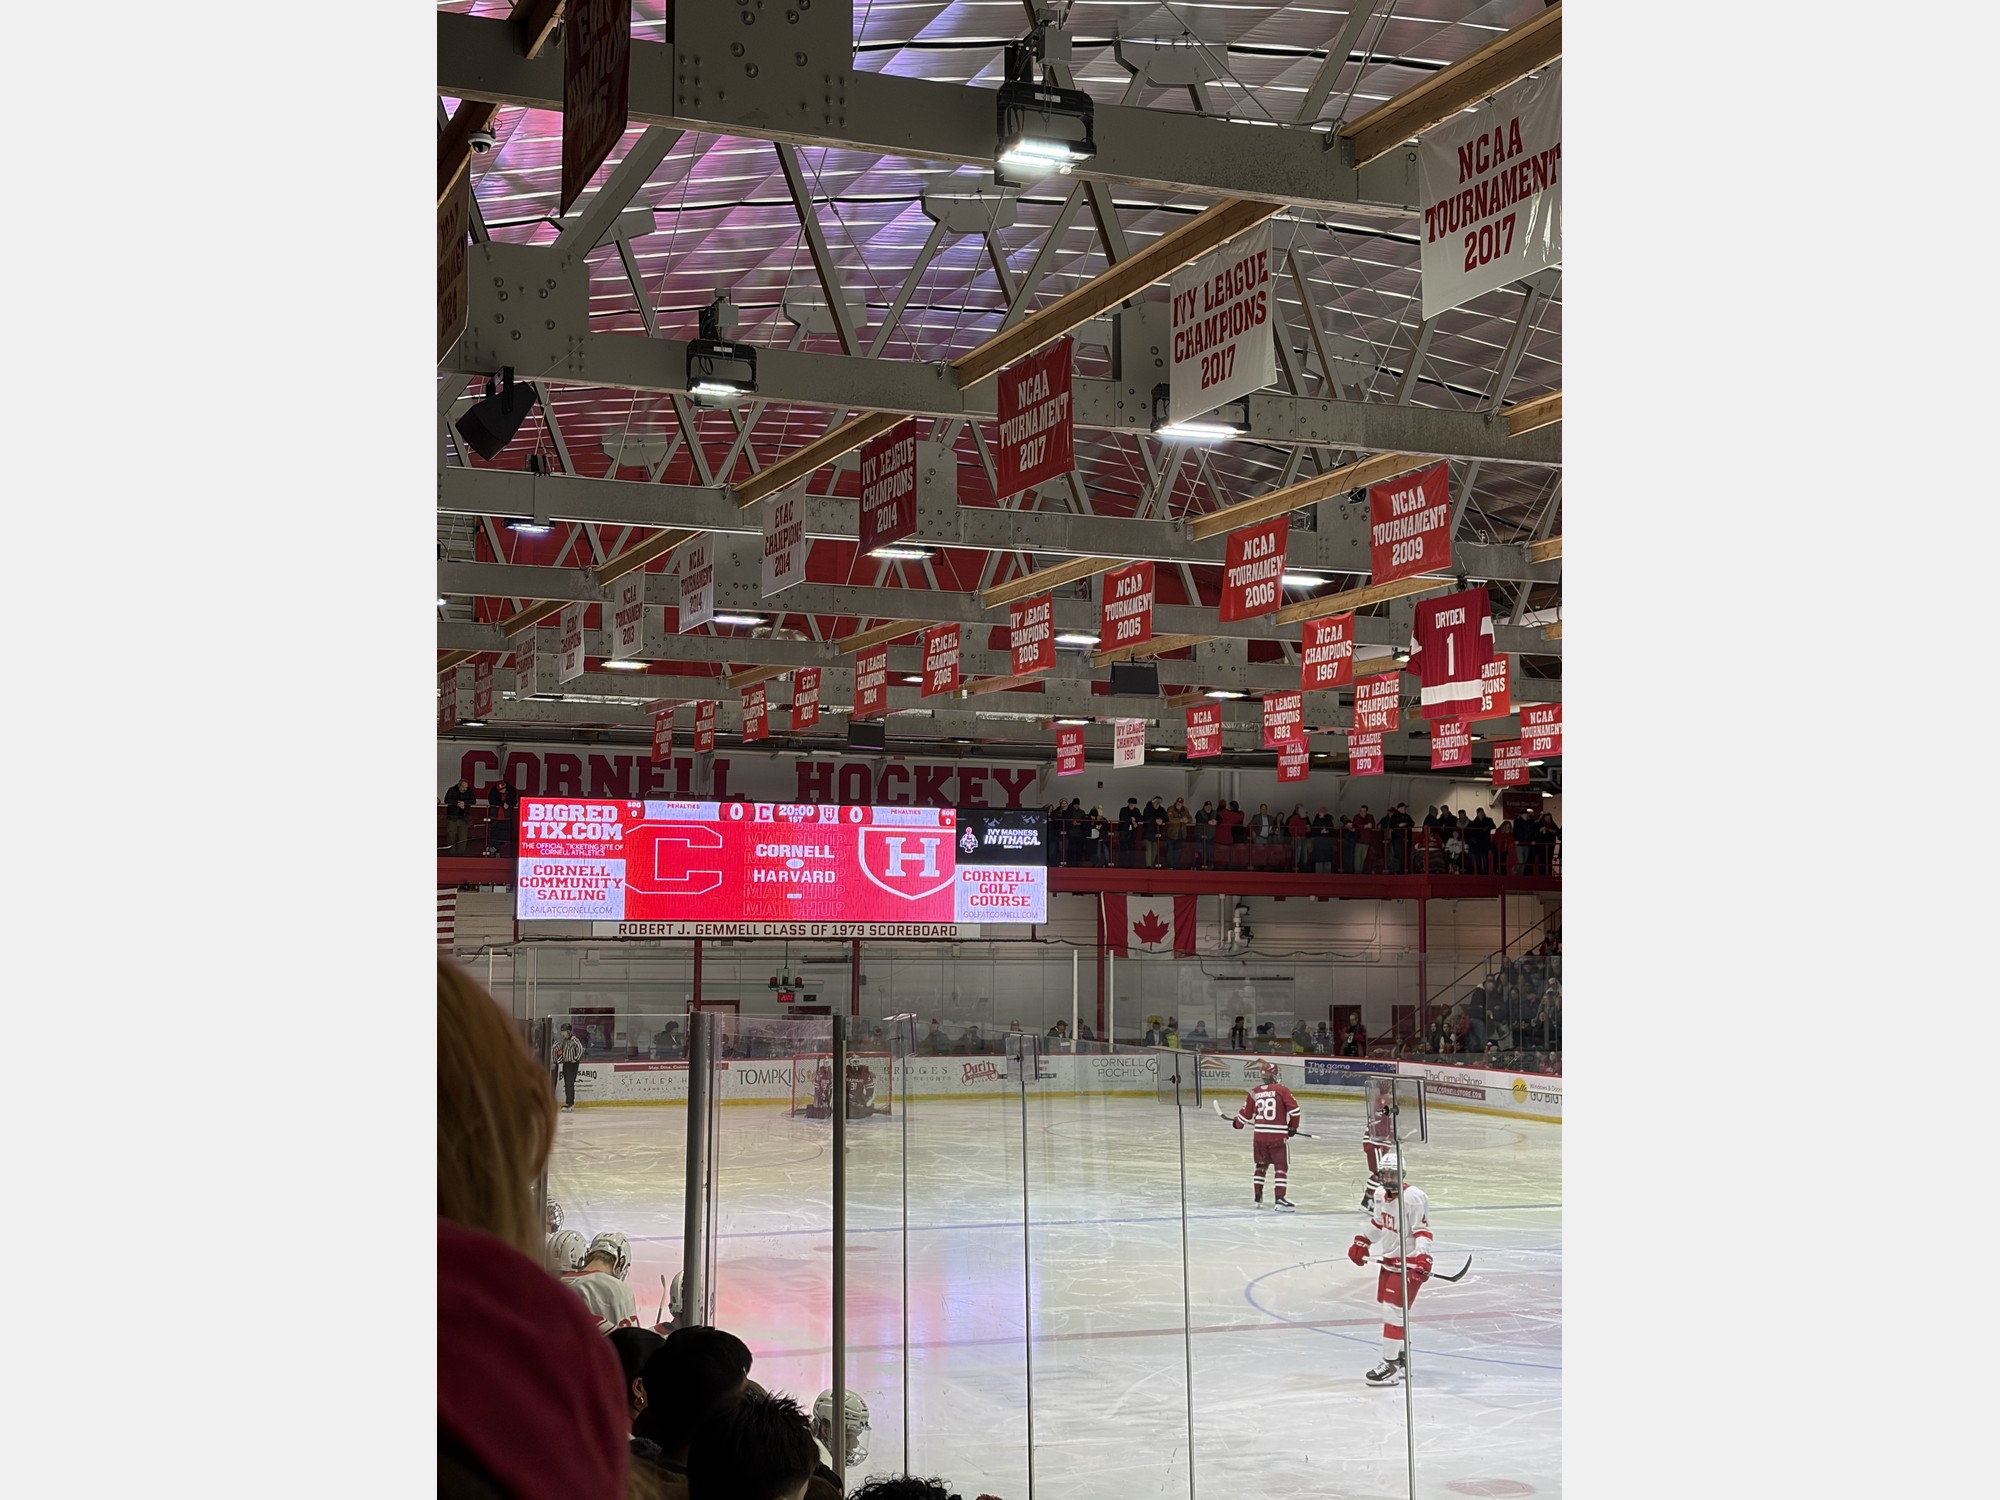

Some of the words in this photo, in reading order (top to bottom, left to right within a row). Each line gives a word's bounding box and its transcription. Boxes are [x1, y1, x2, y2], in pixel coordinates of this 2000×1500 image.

[1458, 117, 1523, 184] NCAA
[1425, 142, 1562, 243] TOURNAMENT
[1464, 212, 1516, 272] 2017
[1173, 286, 1198, 328] IVY
[1203, 249, 1269, 313] LEAGUE
[1174, 290, 1267, 364] CHAMPIONS
[1201, 343, 1236, 391] 2017
[1017, 369, 1050, 410] NCAA
[999, 391, 1069, 449] TOURNAMENT
[862, 456, 879, 486] IVY
[880, 437, 914, 476] LEAGUE
[1020, 435, 1047, 473] 2017
[862, 466, 914, 514] CHAMPIONS
[1391, 486, 1426, 517] NCAA
[775, 500, 794, 529] ECAC
[876, 502, 898, 534] 2014
[1373, 504, 1447, 547] TOURNAMENT
[765, 520, 803, 557] CHAMPIONS
[1243, 532, 1276, 561] NCAA
[689, 546, 705, 572] NCAA
[1392, 537, 1424, 567] 2009
[774, 551, 791, 578] 2014
[1229, 553, 1286, 588] TOURNAMEN
[681, 564, 713, 598] TOURNAMENT
[1115, 573, 1143, 599] NCAA
[689, 591, 703, 615] 2014
[1245, 581, 1275, 609] 2006
[1010, 611, 1023, 631] IVY
[1024, 602, 1050, 627] LEAGUE
[1435, 608, 1466, 629] DRYDEN
[1010, 622, 1050, 648] CHAMPIONS
[1117, 617, 1142, 641] 2005
[1316, 624, 1343, 645] NCAA
[1019, 643, 1039, 664] 2005
[1305, 640, 1353, 665] CHAMPIONS
[1446, 632, 1455, 676] 1
[867, 653, 887, 673] LEAGUE
[1317, 661, 1339, 682] 1967
[857, 669, 886, 691] CHAMPIONS
[933, 667, 952, 686] 2005
[863, 687, 878, 705] 2004
[1356, 684, 1371, 699] IVY
[1372, 679, 1399, 696] LEAGUE
[1264, 699, 1274, 713] IVY
[1275, 695, 1301, 711] LEAGUE
[1357, 694, 1399, 714] CHAMPIONS
[1193, 710, 1213, 725] NCAA
[1264, 709, 1300, 727] CHAMPIONS
[1368, 711, 1387, 727] 1984
[1530, 709, 1554, 725] NCAA
[1116, 724, 1126, 737] IVY
[1126, 722, 1145, 735] LEAGUE
[1187, 723, 1220, 739] TOURNAMENT
[1274, 725, 1291, 739] 1983
[1439, 722, 1461, 735] ECAC
[1521, 723, 1562, 739] TOURNAMENT
[1116, 735, 1145, 750] CHAMPIONS
[1195, 737, 1209, 751] 1981
[1348, 735, 1358, 746] IVY
[1358, 733, 1381, 745] LEAGUE
[1432, 734, 1469, 750] CHAMPIONS
[1532, 738, 1552, 751] 1970
[1124, 748, 1136, 761] 1981
[1348, 745, 1381, 759] CHAMPIONS
[1441, 748, 1459, 761] 1970
[1494, 747, 1504, 758] IVY
[1506, 745, 1522, 757] LEAG
[1356, 758, 1372, 770] 1970
[1494, 757, 1529, 770] CHAMPIONS
[461, 750, 745, 800] CORNELL
[795, 761, 1037, 808] HOCKEY
[528, 803, 618, 823] BIGRED
[631, 810, 638, 818] 0
[729, 803, 744, 820] 0
[778, 805, 815, 816] 20:00
[849, 806, 863, 823] 0
[522, 822, 623, 841] TIX.COM
[984, 835, 998, 845] IN
[997, 835, 1041, 846] ITHACA.
[1001, 829, 1038, 837] MADNESS
[536, 842, 564, 851] OFFICIAL
[566, 843, 599, 851] TICKETING
[600, 843, 613, 851] SITE
[540, 849, 570, 857] CORNELL
[571, 849, 606, 857] ATHLETICS
[755, 844, 835, 858] CORNELL
[884, 837, 941, 877] H
[533, 864, 611, 877] CORNELL
[753, 869, 836, 883] HARVARD
[962, 871, 1035, 883] CORNELL
[519, 877, 624, 889] COMMUNITY
[979, 884, 1019, 895] GOLF
[537, 890, 606, 901] SAILING
[970, 896, 1031, 907] COURSE
[530, 906, 613, 914] SAILATCORNELL.COM
[743, 901, 846, 916] MATCHUP
[963, 911, 1038, 920] GOLFATCORNELL.COM
[618, 923, 674, 935] ROBERT
[677, 923, 690, 935] J.
[695, 924, 760, 936] GEMMELL
[763, 924, 806, 936] CLASS
[811, 925, 828, 936] OF
[832, 925, 865, 936] 1979
[869, 925, 958, 937] SCOREBOARD
[883, 1067, 948, 1075] BRDGES
[962, 1060, 998, 1076] Purity
[1091, 1058, 1145, 1067] CORNELL
[1097, 1068, 1145, 1077] POCHILY
[1201, 1070, 1231, 1078] ELLIVER
[1255, 1097, 1276, 1121] 28
